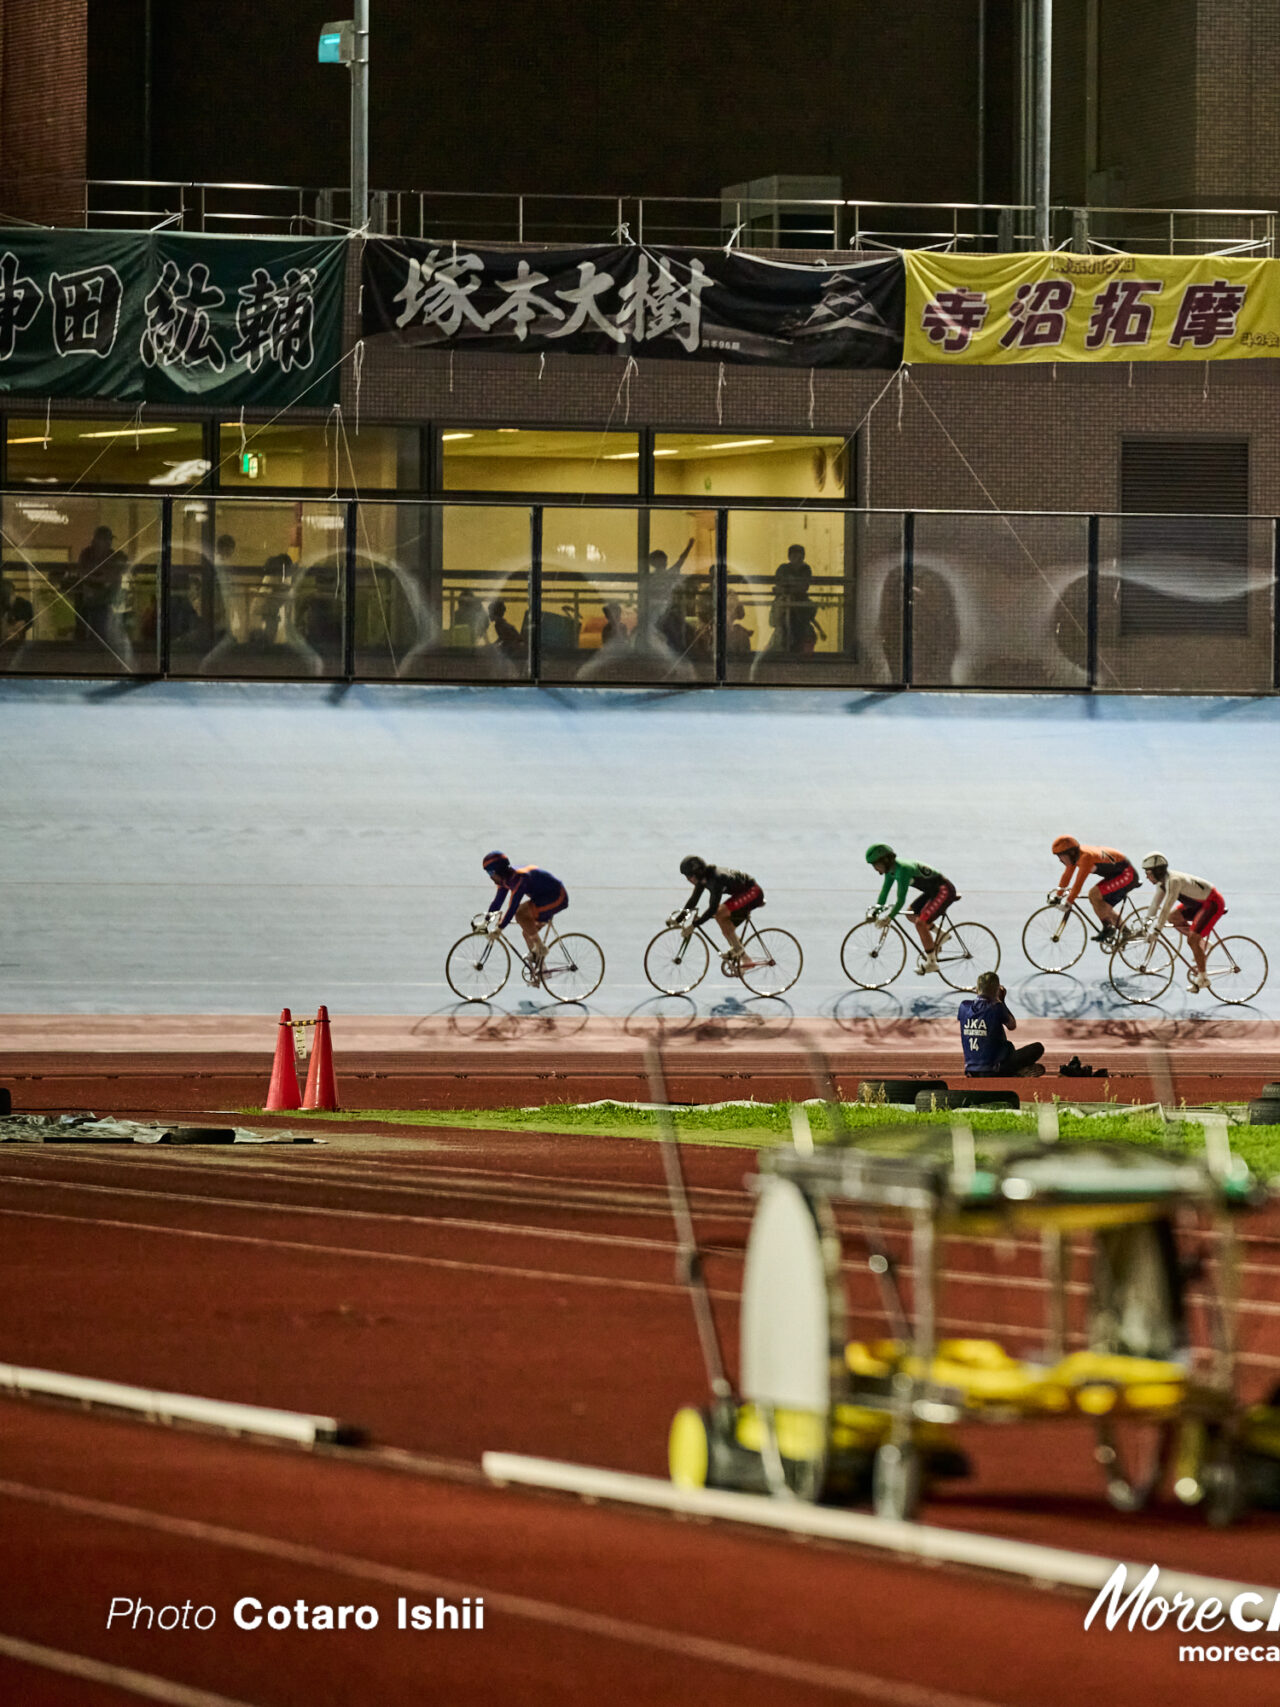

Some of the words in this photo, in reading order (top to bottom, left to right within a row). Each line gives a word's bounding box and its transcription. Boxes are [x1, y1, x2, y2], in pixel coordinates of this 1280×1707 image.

[394, 249, 714, 352] 塚本大樹
[920, 279, 1247, 355] 寺沼拓摩
[963, 1018, 988, 1030] JKA
[968, 1037, 980, 1051] 14
